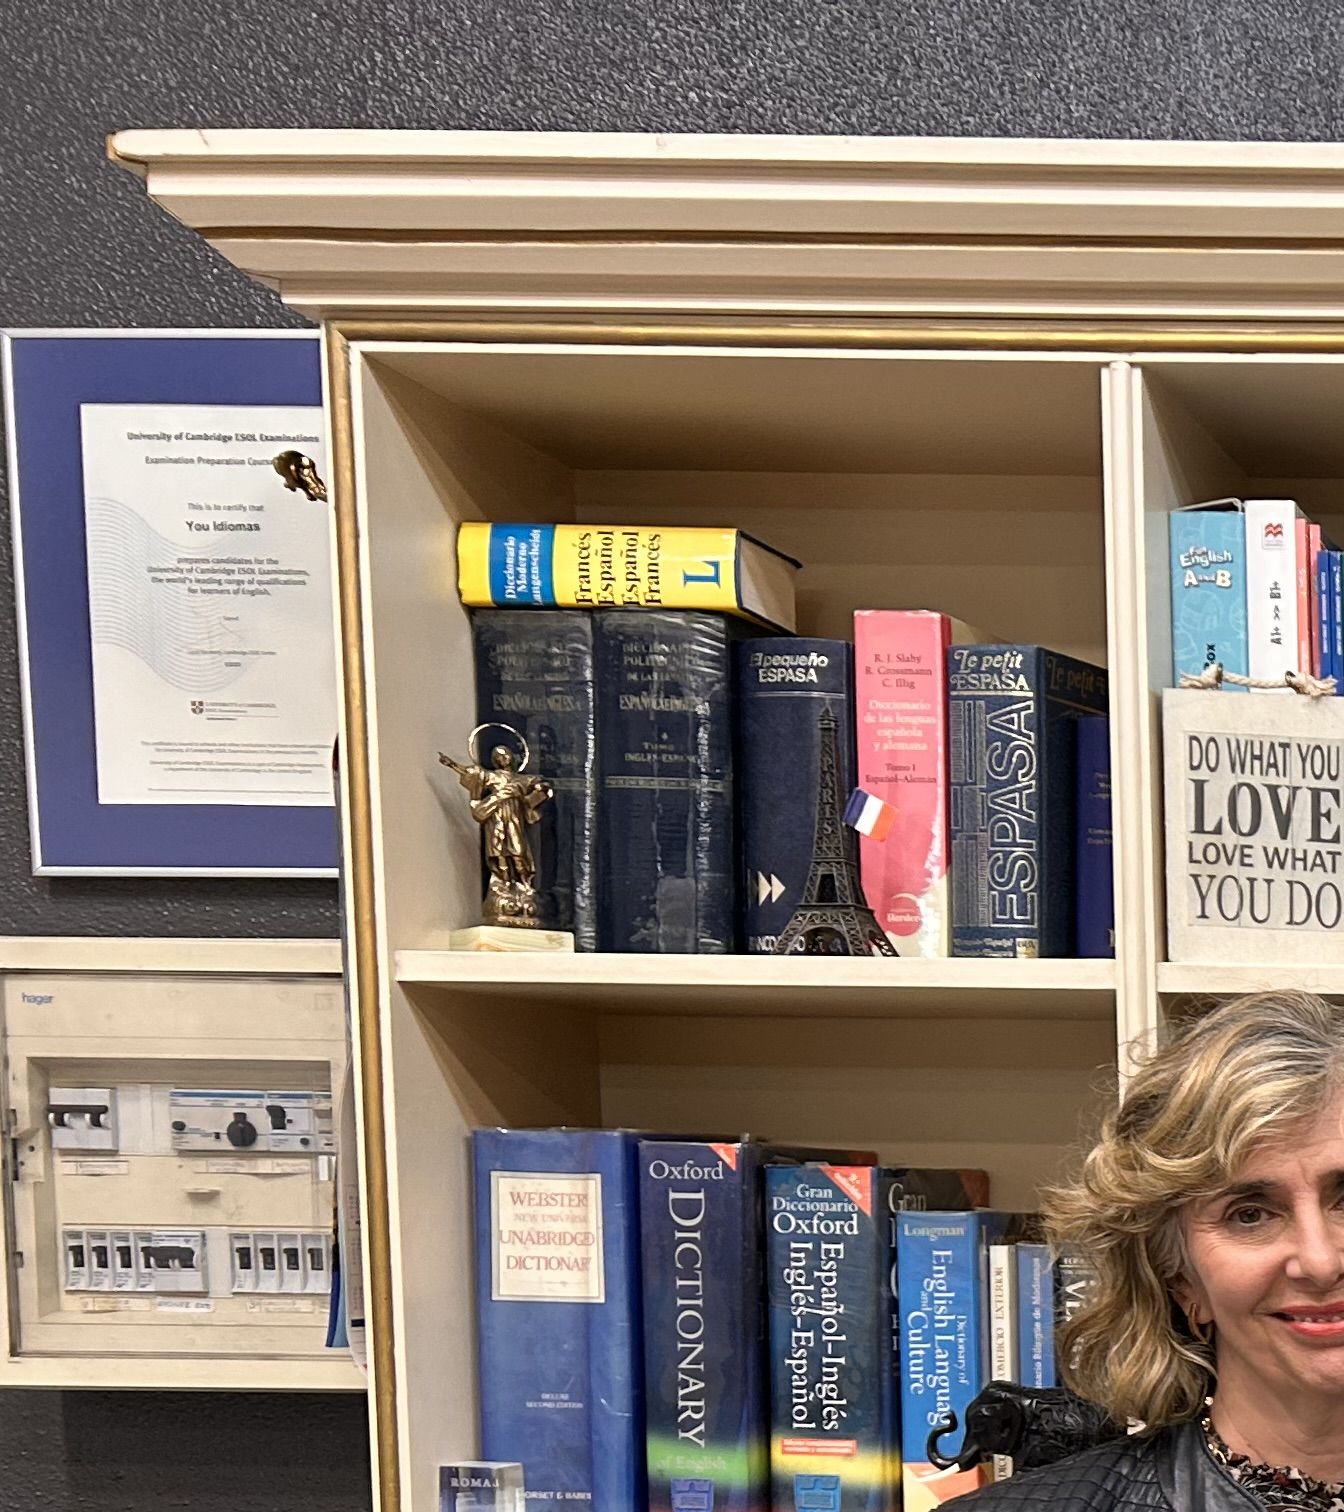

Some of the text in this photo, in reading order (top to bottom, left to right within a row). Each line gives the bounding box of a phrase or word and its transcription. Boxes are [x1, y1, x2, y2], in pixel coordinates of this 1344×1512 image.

[127, 432, 319, 442] University of Cambridge ESOL Examinations
[146, 456, 273, 466] Examination Preparation Cours
[223, 504, 247, 512] certify
[186, 521, 260, 532] You Idiomas
[504, 536, 516, 599] Diccionario
[518, 542, 527, 592] Moderno
[594, 530, 616, 606] Español
[1179, 550, 1232, 568] English
[572, 532, 592, 605] Francés
[620, 531, 640, 606] Español
[642, 533, 662, 606] Francés
[682, 561, 720, 588] L
[1184, 570, 1199, 587] A
[1216, 570, 1232, 588] B
[763, 652, 829, 669] pequeño
[874, 654, 922, 665] R. J. Slaby
[953, 650, 1024, 675] Le petit
[758, 669, 818, 683] ESPASA
[865, 666, 932, 676] R. Grossmann
[882, 679, 892, 688] C.
[950, 674, 1029, 692] ESPASA
[869, 700, 931, 711] Diccionario
[863, 714, 936, 726] de las lenguas
[877, 727, 923, 739] española
[873, 741, 927, 752] y alemana
[1189, 735, 1340, 781] DO WHAT YOU
[885, 763, 908, 772] Tomo
[985, 700, 1038, 928] ESPASA
[1189, 778, 1341, 844] LOVE
[1188, 841, 1342, 874] LOVE WHAT
[1189, 873, 1342, 929] YOU DO
[22, 992, 54, 1004] hager
[649, 1161, 724, 1180] Oxford
[796, 1184, 833, 1199] Gran
[772, 1197, 858, 1213] Diccionario
[773, 1212, 860, 1235] Oxford
[904, 1224, 965, 1242] Longman
[919, 1291, 932, 1312] and
[668, 1188, 706, 1447] DICTIONARY
[783, 1242, 815, 1429] Inglés-Español
[813, 1242, 848, 1430] Español-Inglés
[923, 1249, 956, 1432] English Languag
[907, 1311, 930, 1396] Culture
[954, 1315, 969, 1386] Dictionary of
[994, 1326, 1005, 1380] OMERCIO
[676, 1456, 727, 1472] English
[450, 1478, 490, 1488] ROMA
